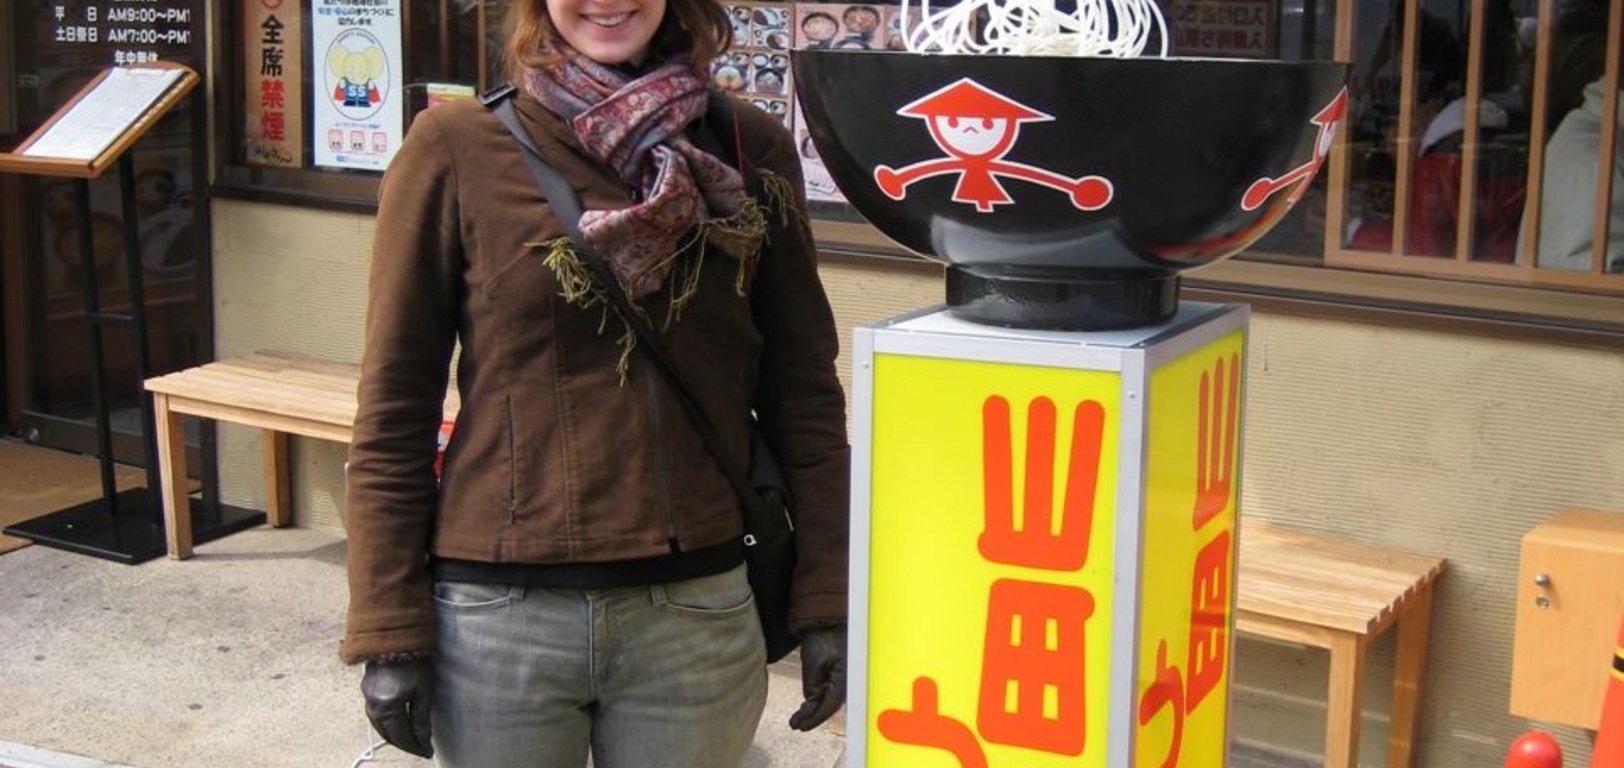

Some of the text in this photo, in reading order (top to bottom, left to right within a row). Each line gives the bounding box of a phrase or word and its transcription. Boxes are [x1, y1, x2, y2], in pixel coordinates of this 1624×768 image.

[87, 6, 97, 22] 日
[260, 14, 285, 141] 全席禁煙
[348, 84, 366, 98] SS
[977, 394, 1106, 757] 山田
